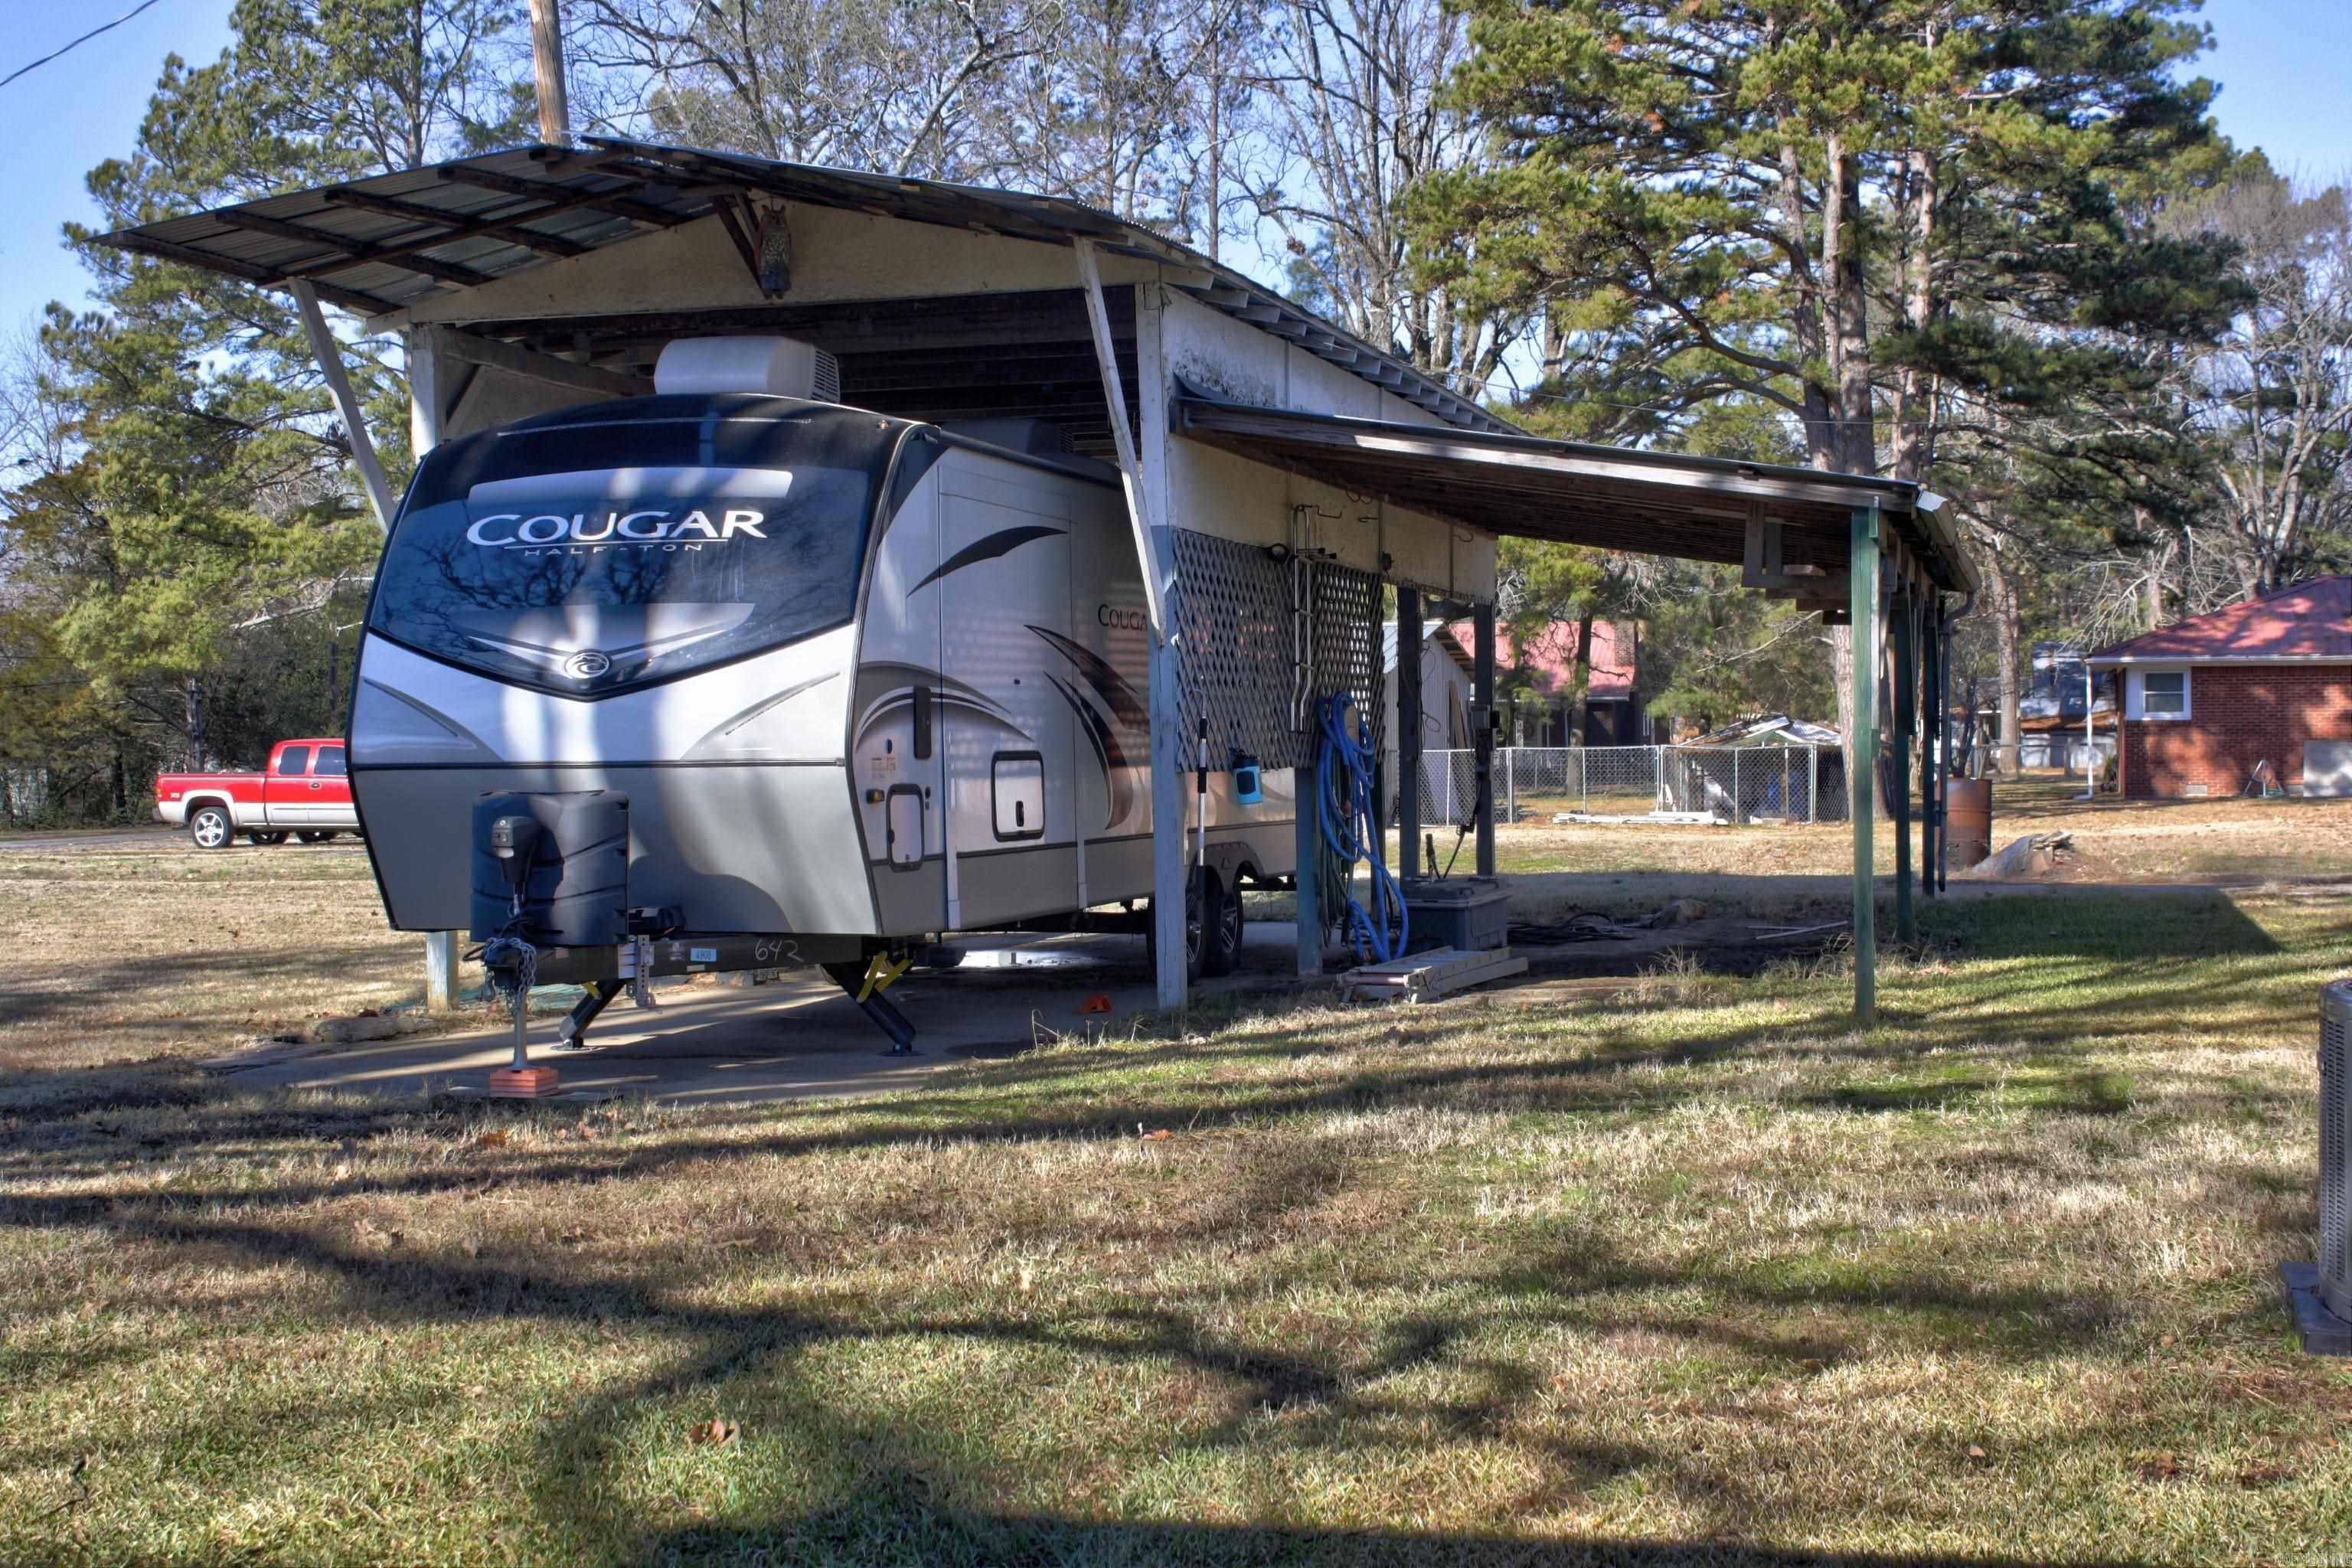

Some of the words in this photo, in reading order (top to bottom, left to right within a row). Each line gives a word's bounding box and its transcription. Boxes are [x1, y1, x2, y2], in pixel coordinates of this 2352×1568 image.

[466, 510, 768, 547] COUGAR
[524, 544, 703, 557] HALF-TON
[1097, 604, 1148, 631] COUGA
[754, 938, 804, 962] 642
